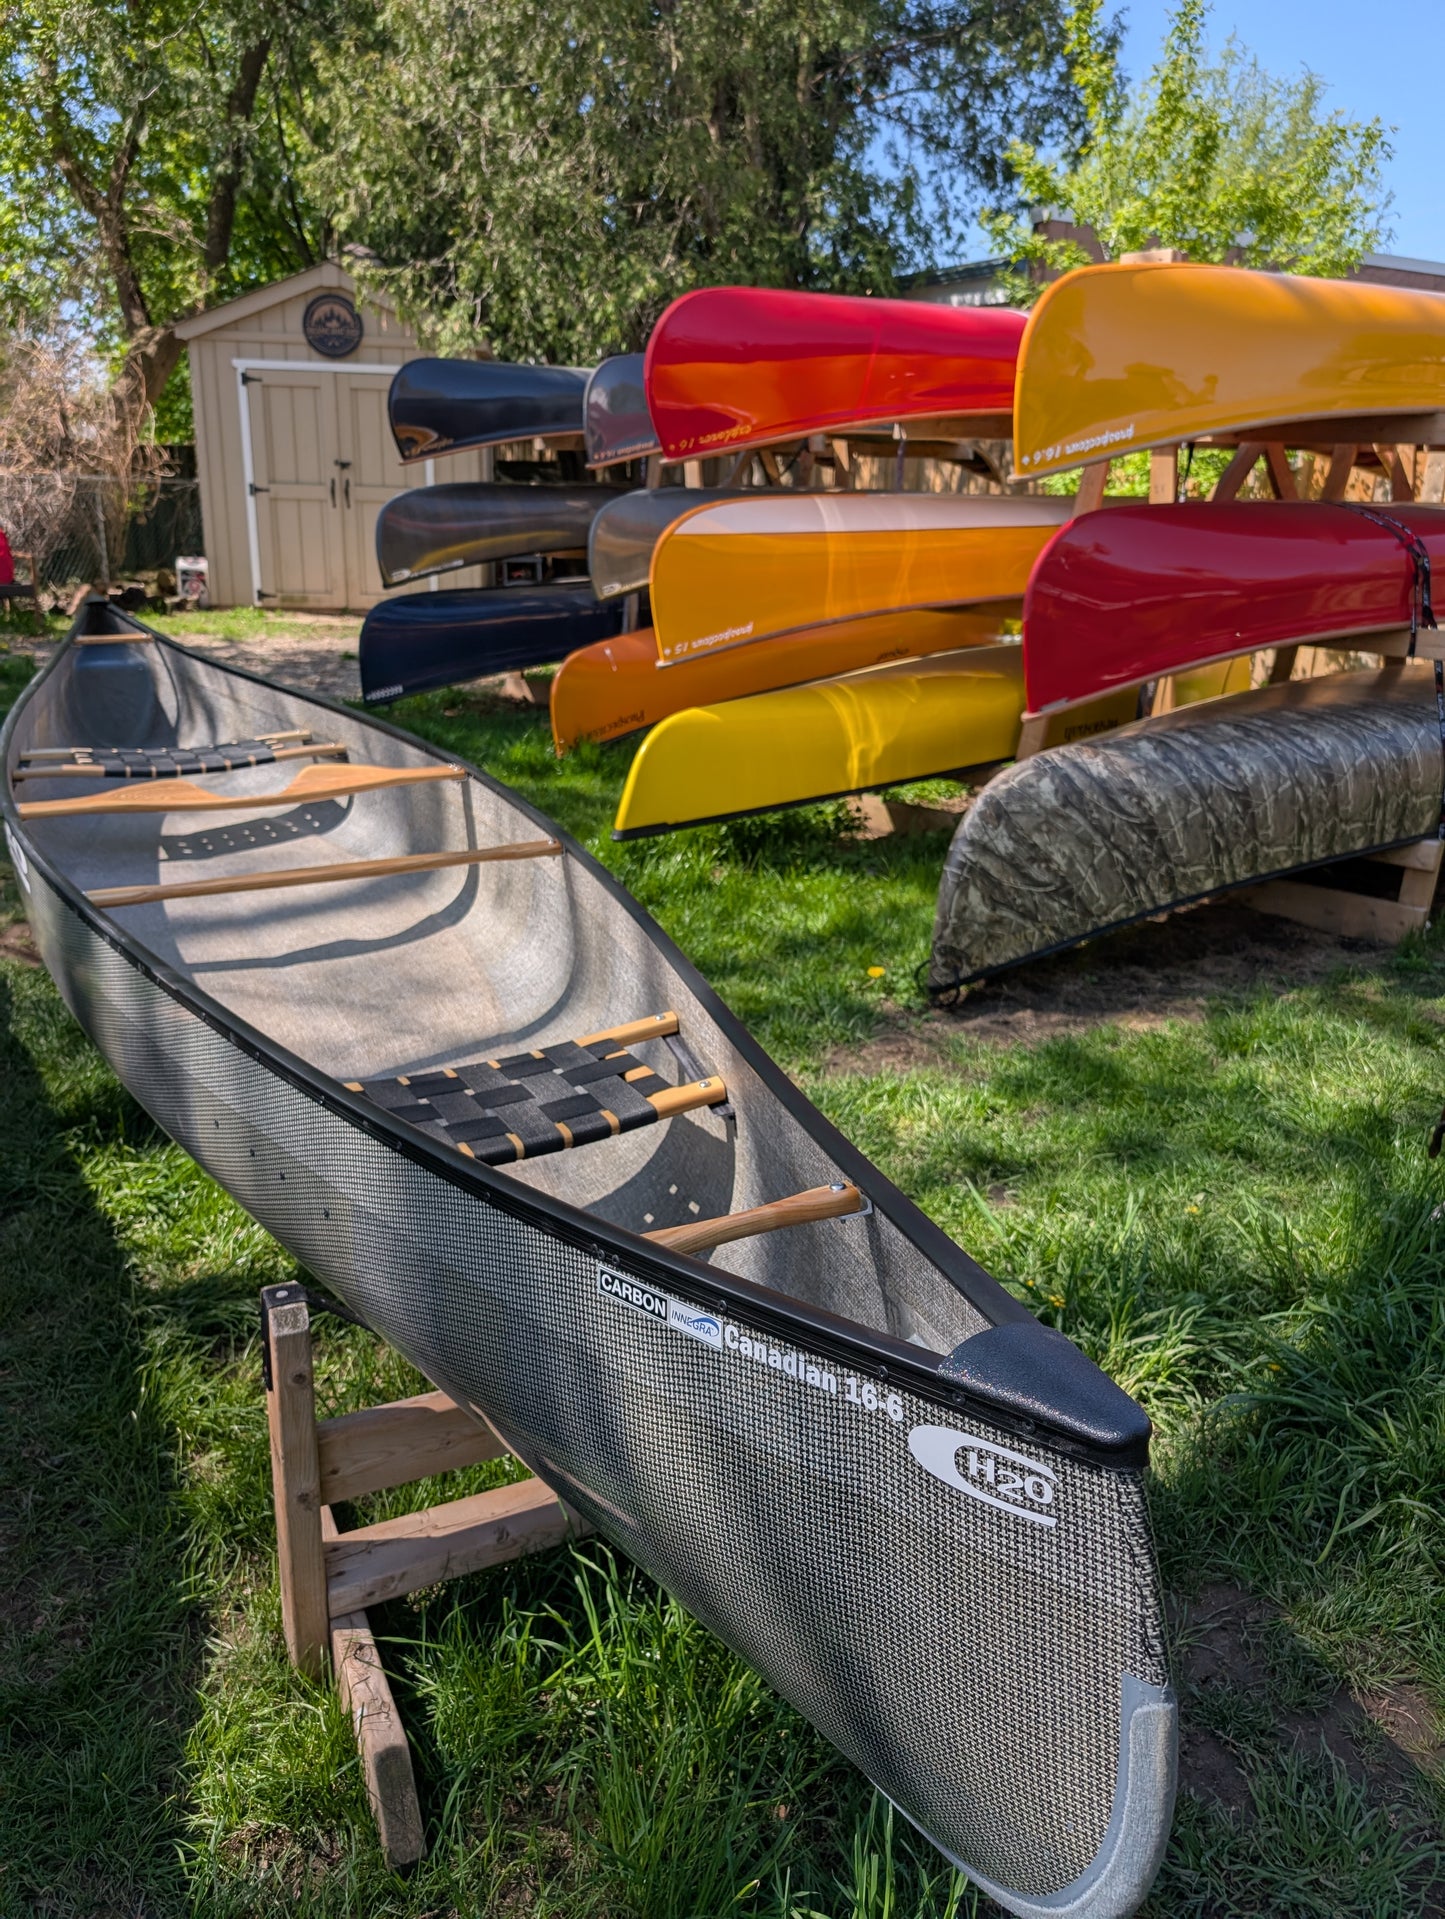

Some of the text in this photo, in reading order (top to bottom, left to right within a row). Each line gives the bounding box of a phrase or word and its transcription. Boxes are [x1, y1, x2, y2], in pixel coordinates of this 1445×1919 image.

[680, 437, 695, 450] 16
[675, 641, 689, 655] 15
[600, 1273, 666, 1318] CARBON
[671, 1309, 713, 1337] INNEGRA
[724, 1324, 905, 1422] Canadian 16-6
